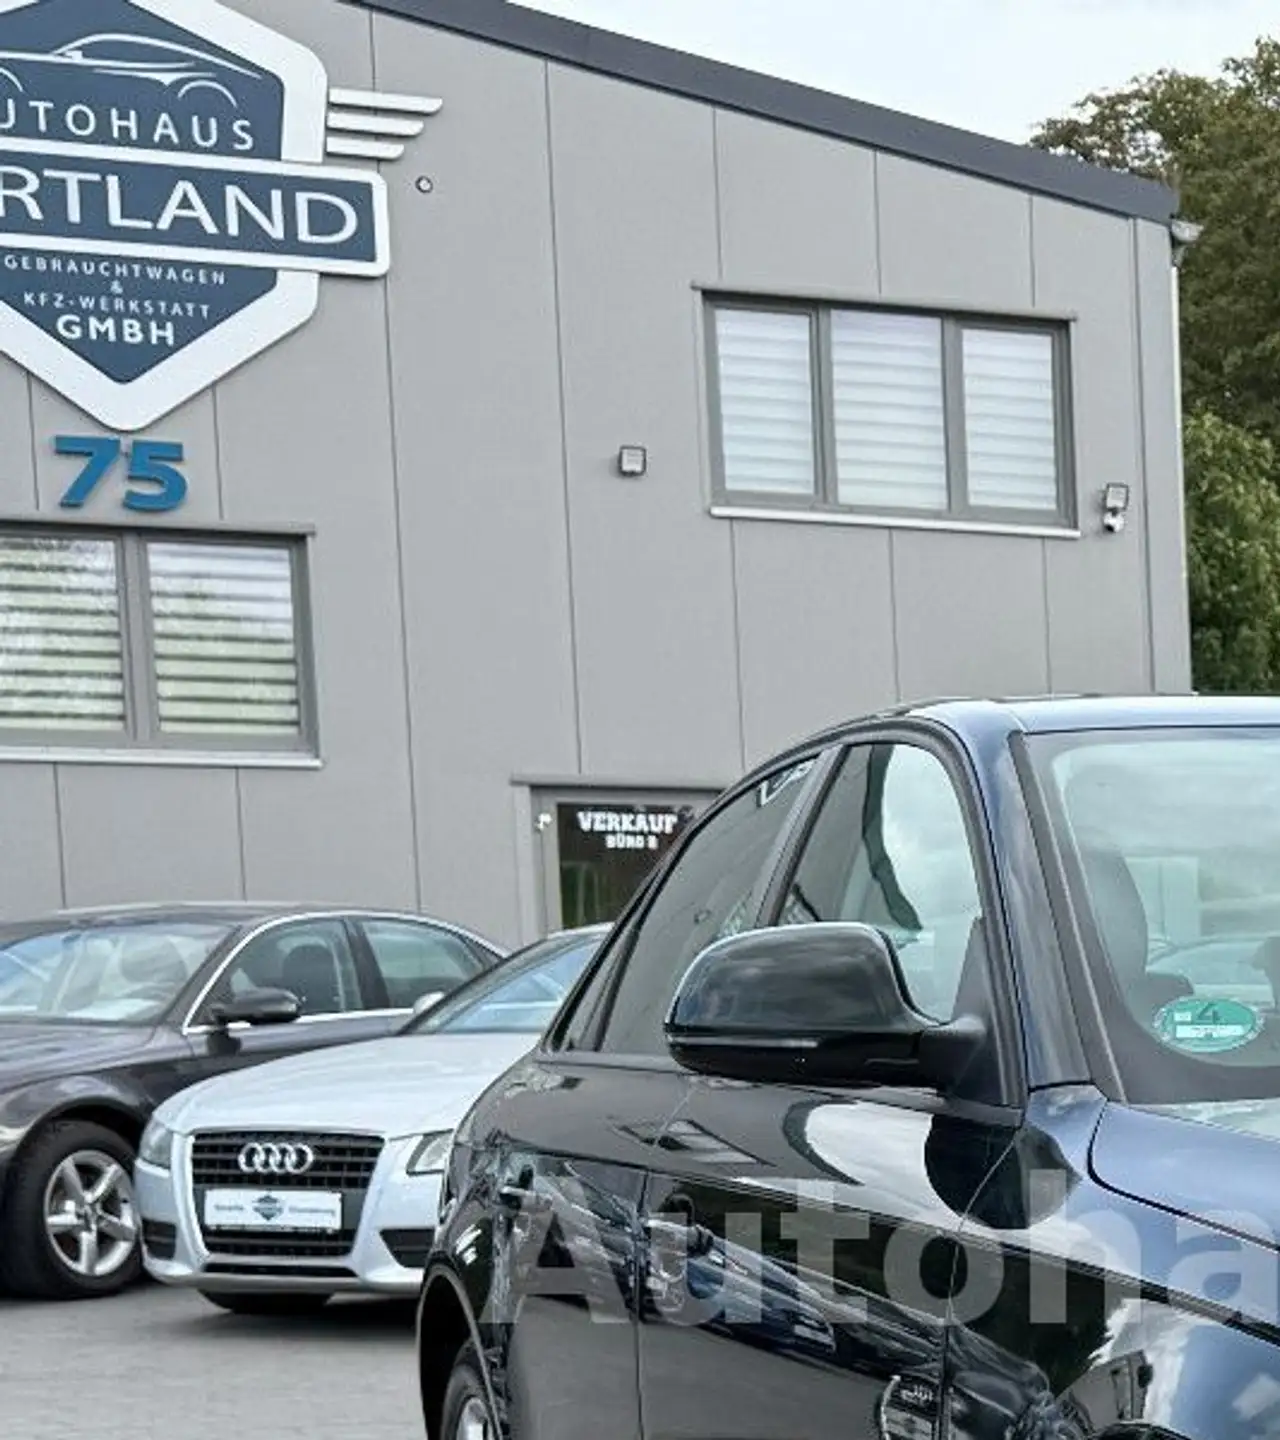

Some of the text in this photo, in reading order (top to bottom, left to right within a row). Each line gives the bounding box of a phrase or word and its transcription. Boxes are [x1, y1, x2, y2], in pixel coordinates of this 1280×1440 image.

[3, 254, 226, 285] GEBRAUCHTWAGEN
[110, 279, 124, 295] &
[23, 291, 210, 319] KFZ-WERKSTATT
[56, 313, 175, 347] GMBH
[54, 434, 188, 512] 75
[576, 810, 678, 835] VERKAUF
